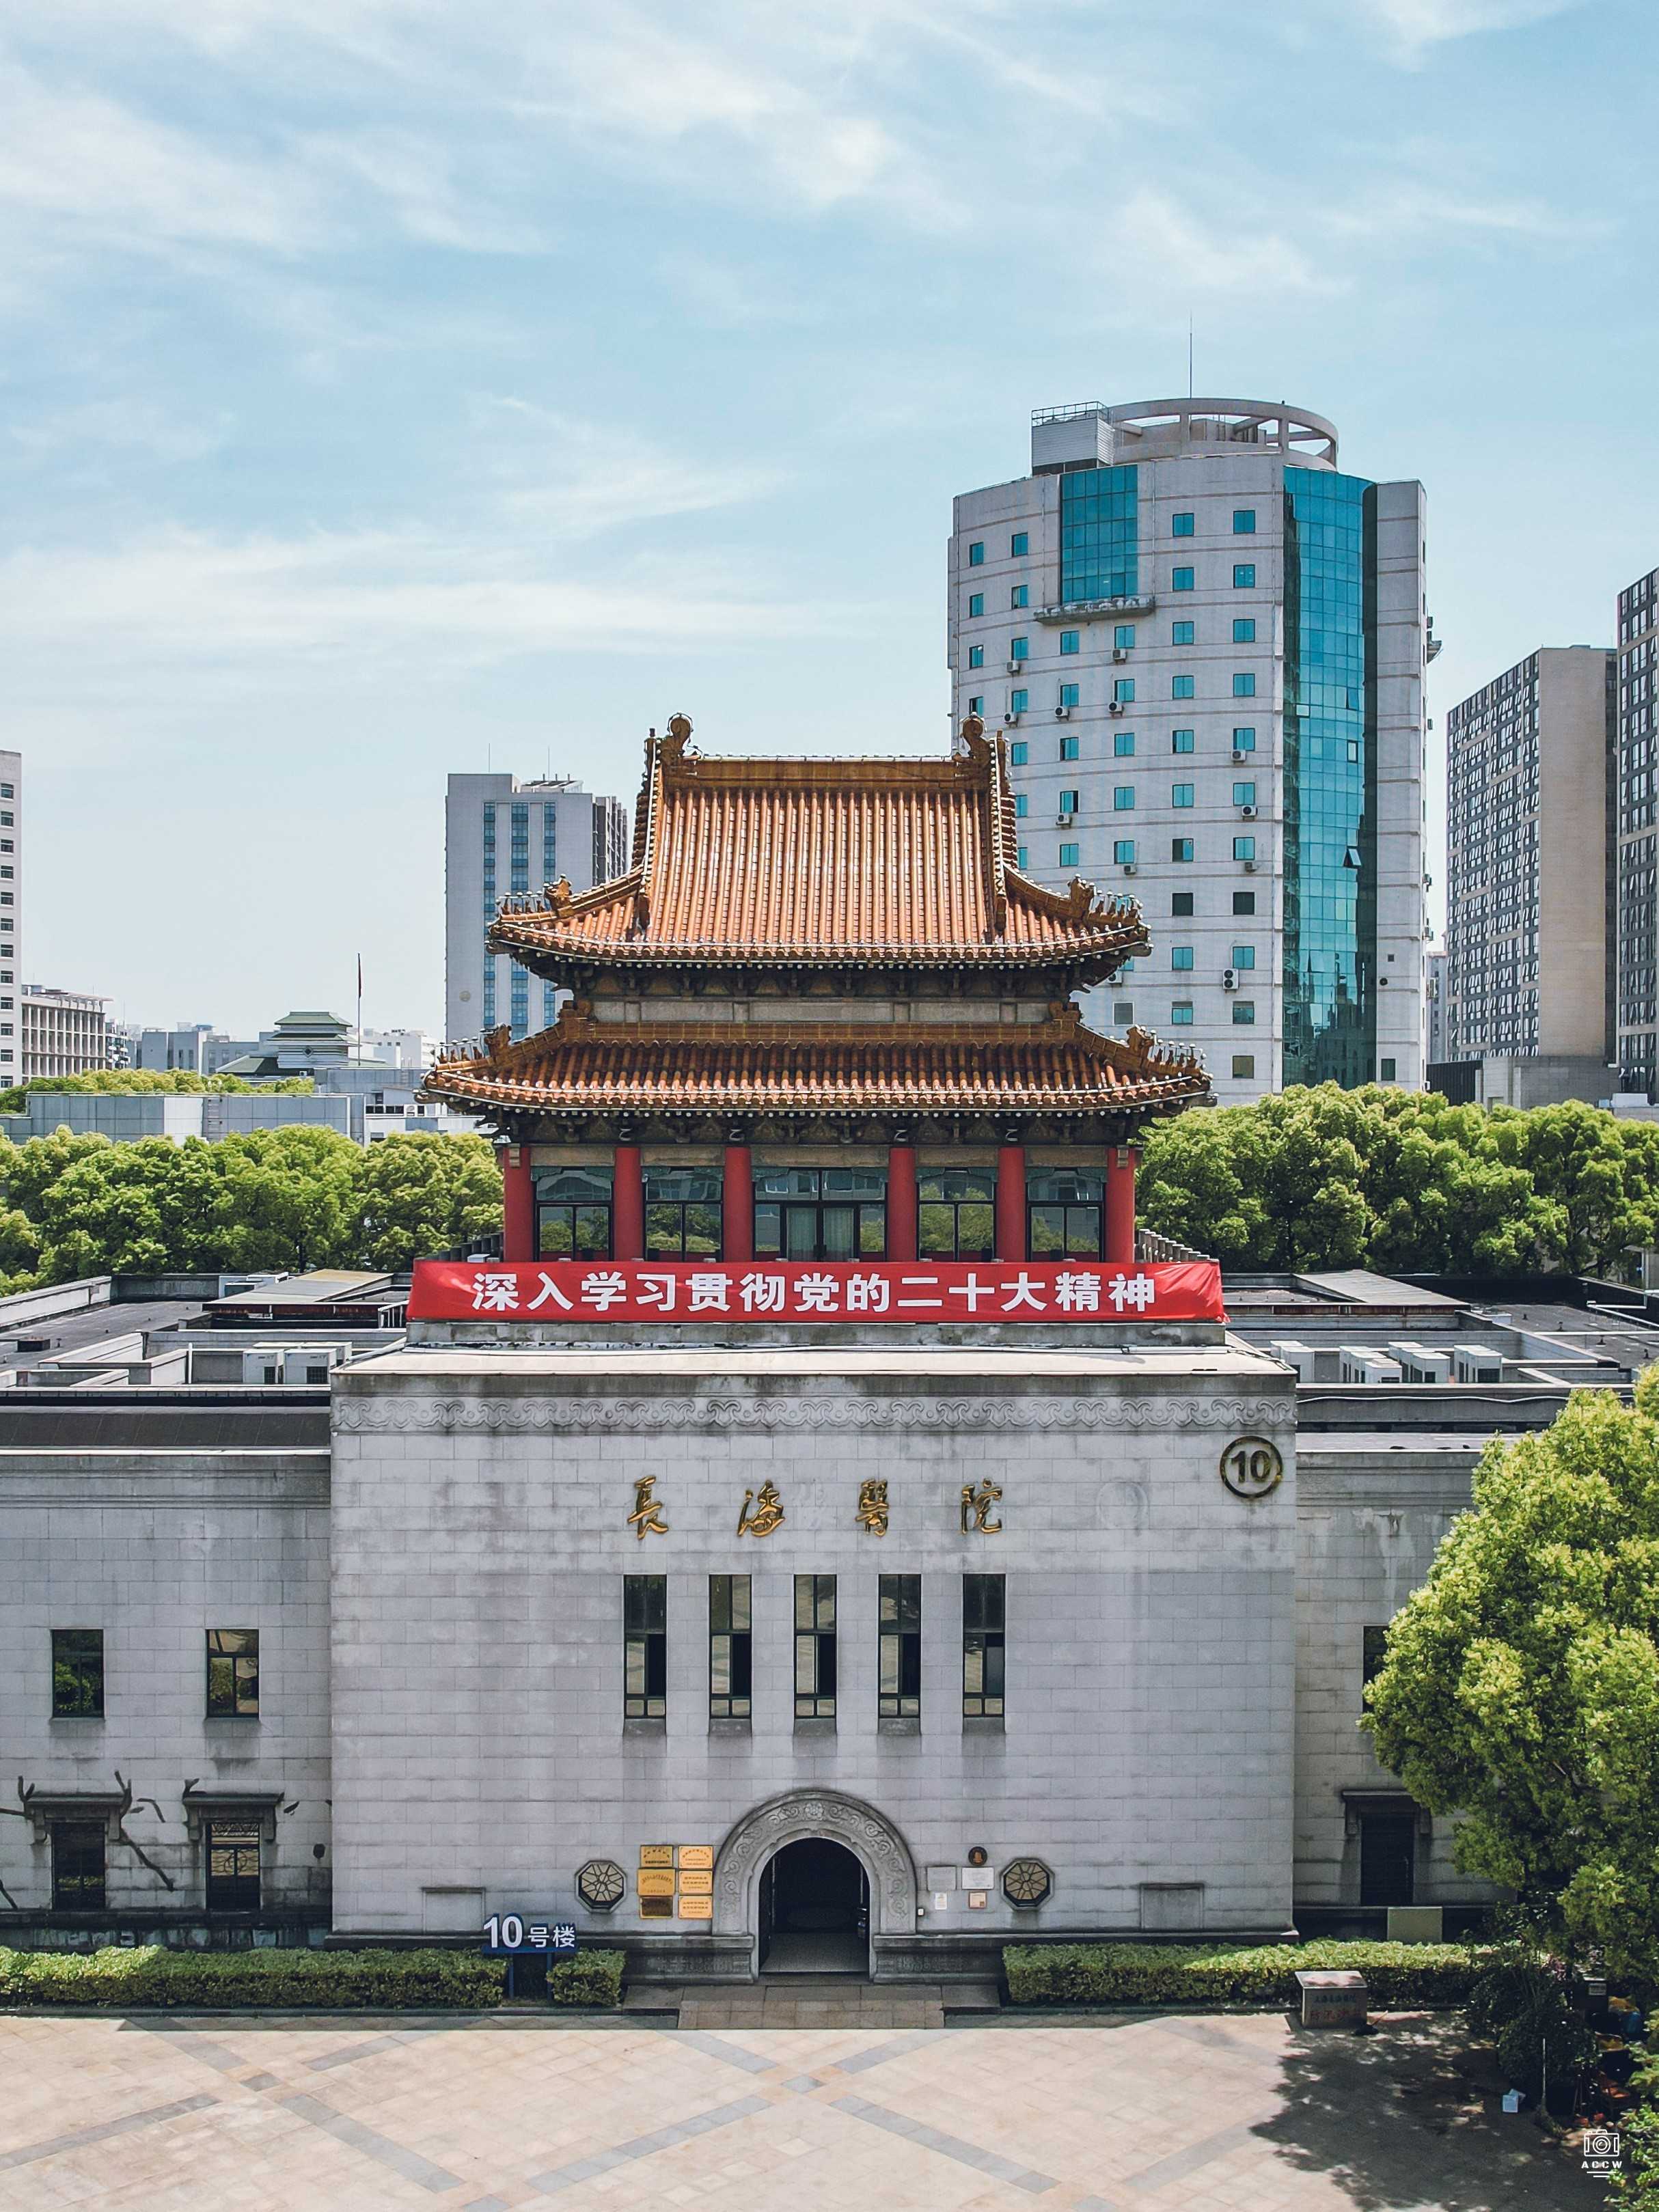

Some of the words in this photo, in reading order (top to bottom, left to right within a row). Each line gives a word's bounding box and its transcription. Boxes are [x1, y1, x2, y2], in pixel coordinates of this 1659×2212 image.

[471, 1271, 1155, 1312] 深入学习贯彻党的二十大精神
[1231, 1450, 1272, 1484] 10
[483, 1916, 575, 1948] 10号楼
